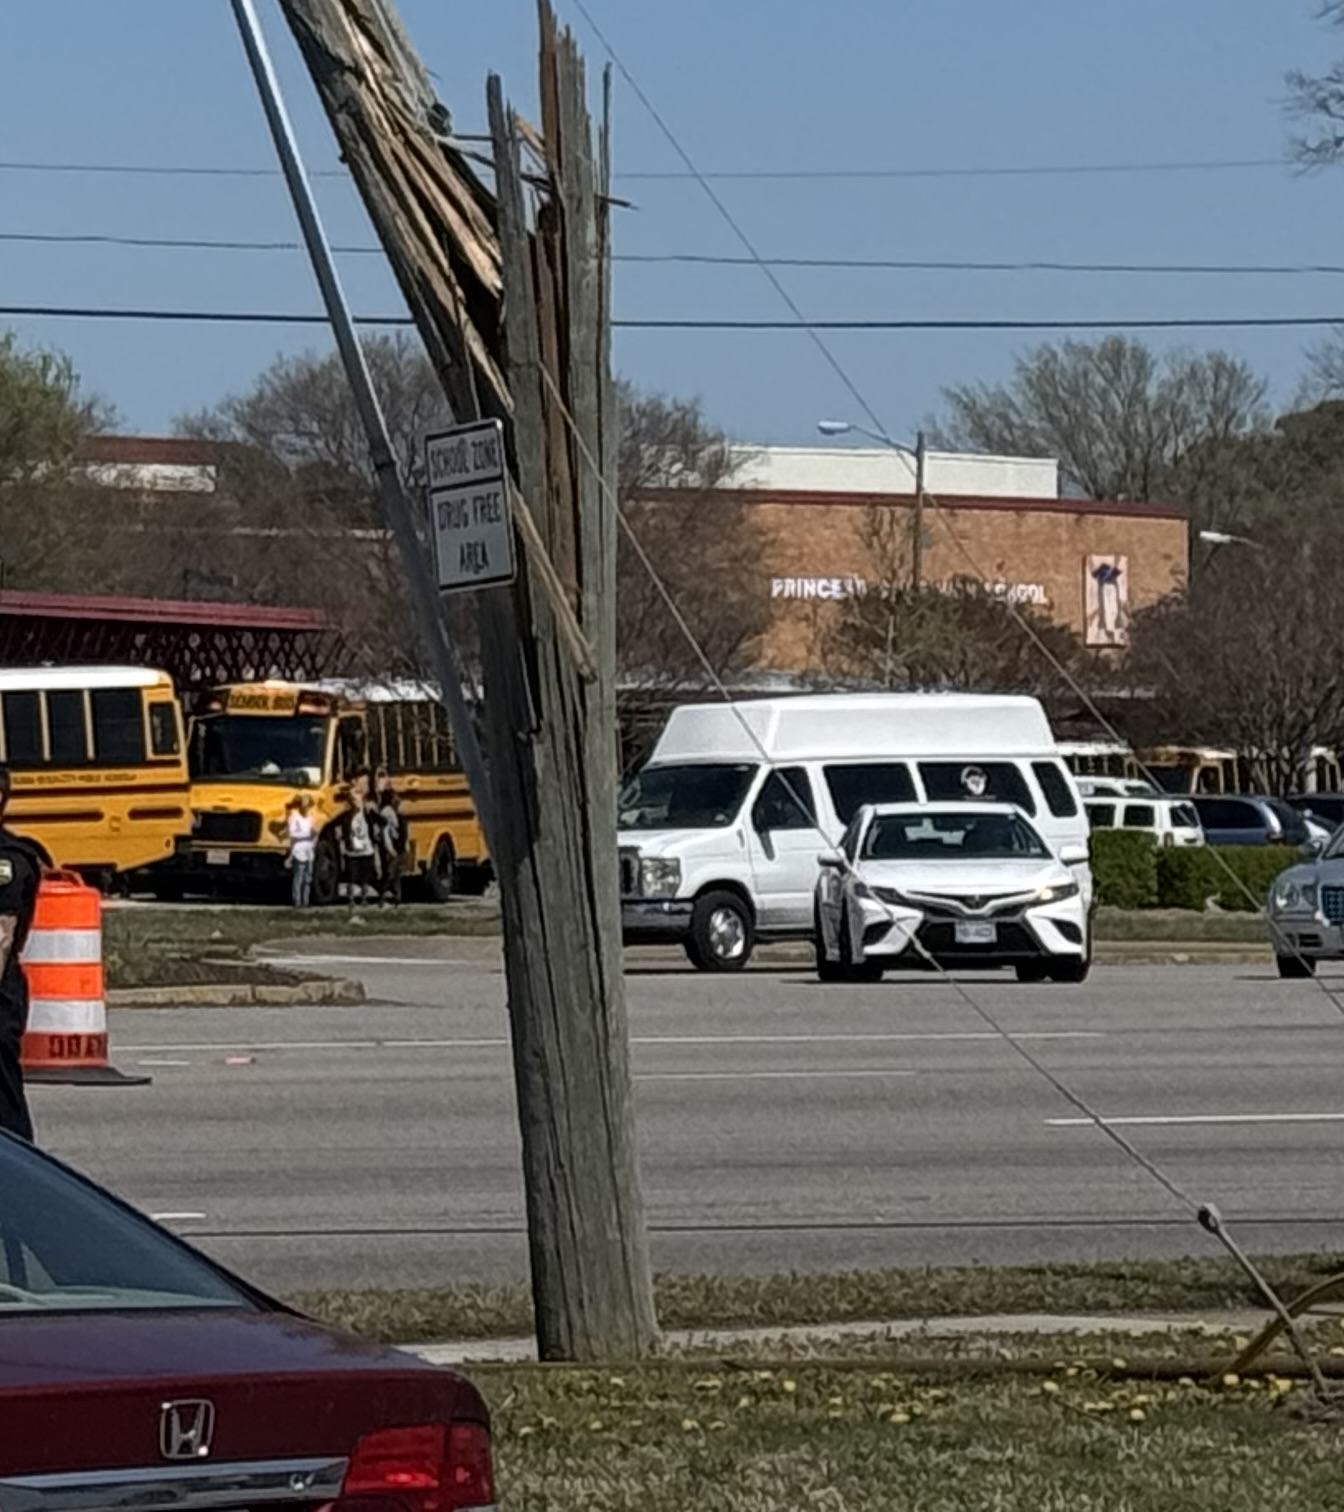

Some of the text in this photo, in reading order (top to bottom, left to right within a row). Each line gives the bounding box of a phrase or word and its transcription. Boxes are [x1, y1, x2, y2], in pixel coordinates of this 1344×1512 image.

[430, 439, 499, 481] SCHOOL ZONE
[437, 491, 502, 531] DRUG FREE
[459, 540, 490, 575] AREA
[772, 577, 867, 599] PRINCE
